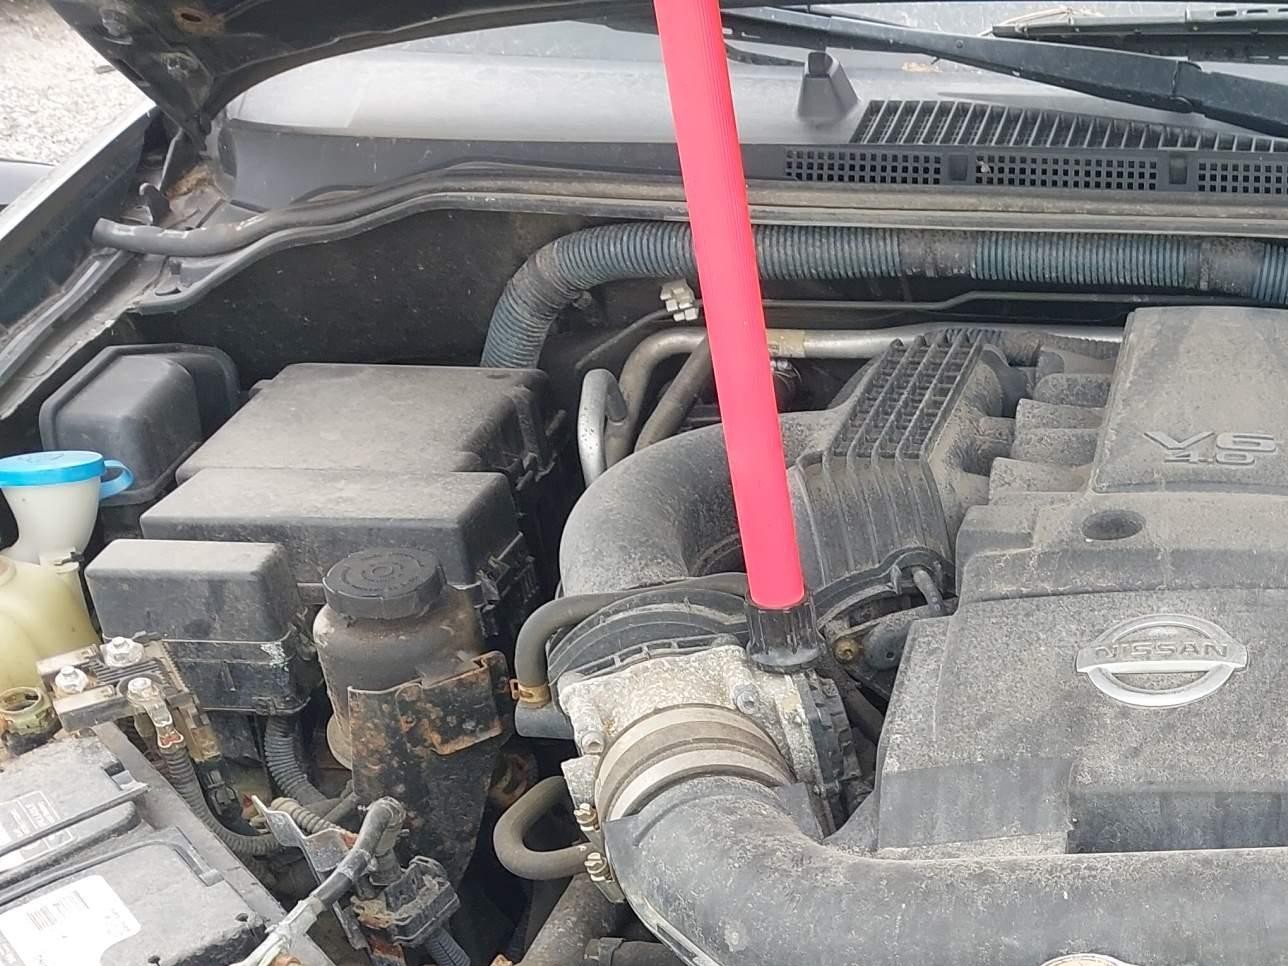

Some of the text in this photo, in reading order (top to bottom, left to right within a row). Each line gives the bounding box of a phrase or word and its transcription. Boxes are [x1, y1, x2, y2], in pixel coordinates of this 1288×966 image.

[1143, 431, 1276, 453] V6
[1164, 451, 1255, 466] 4.0
[1095, 641, 1228, 658] NISSAN
